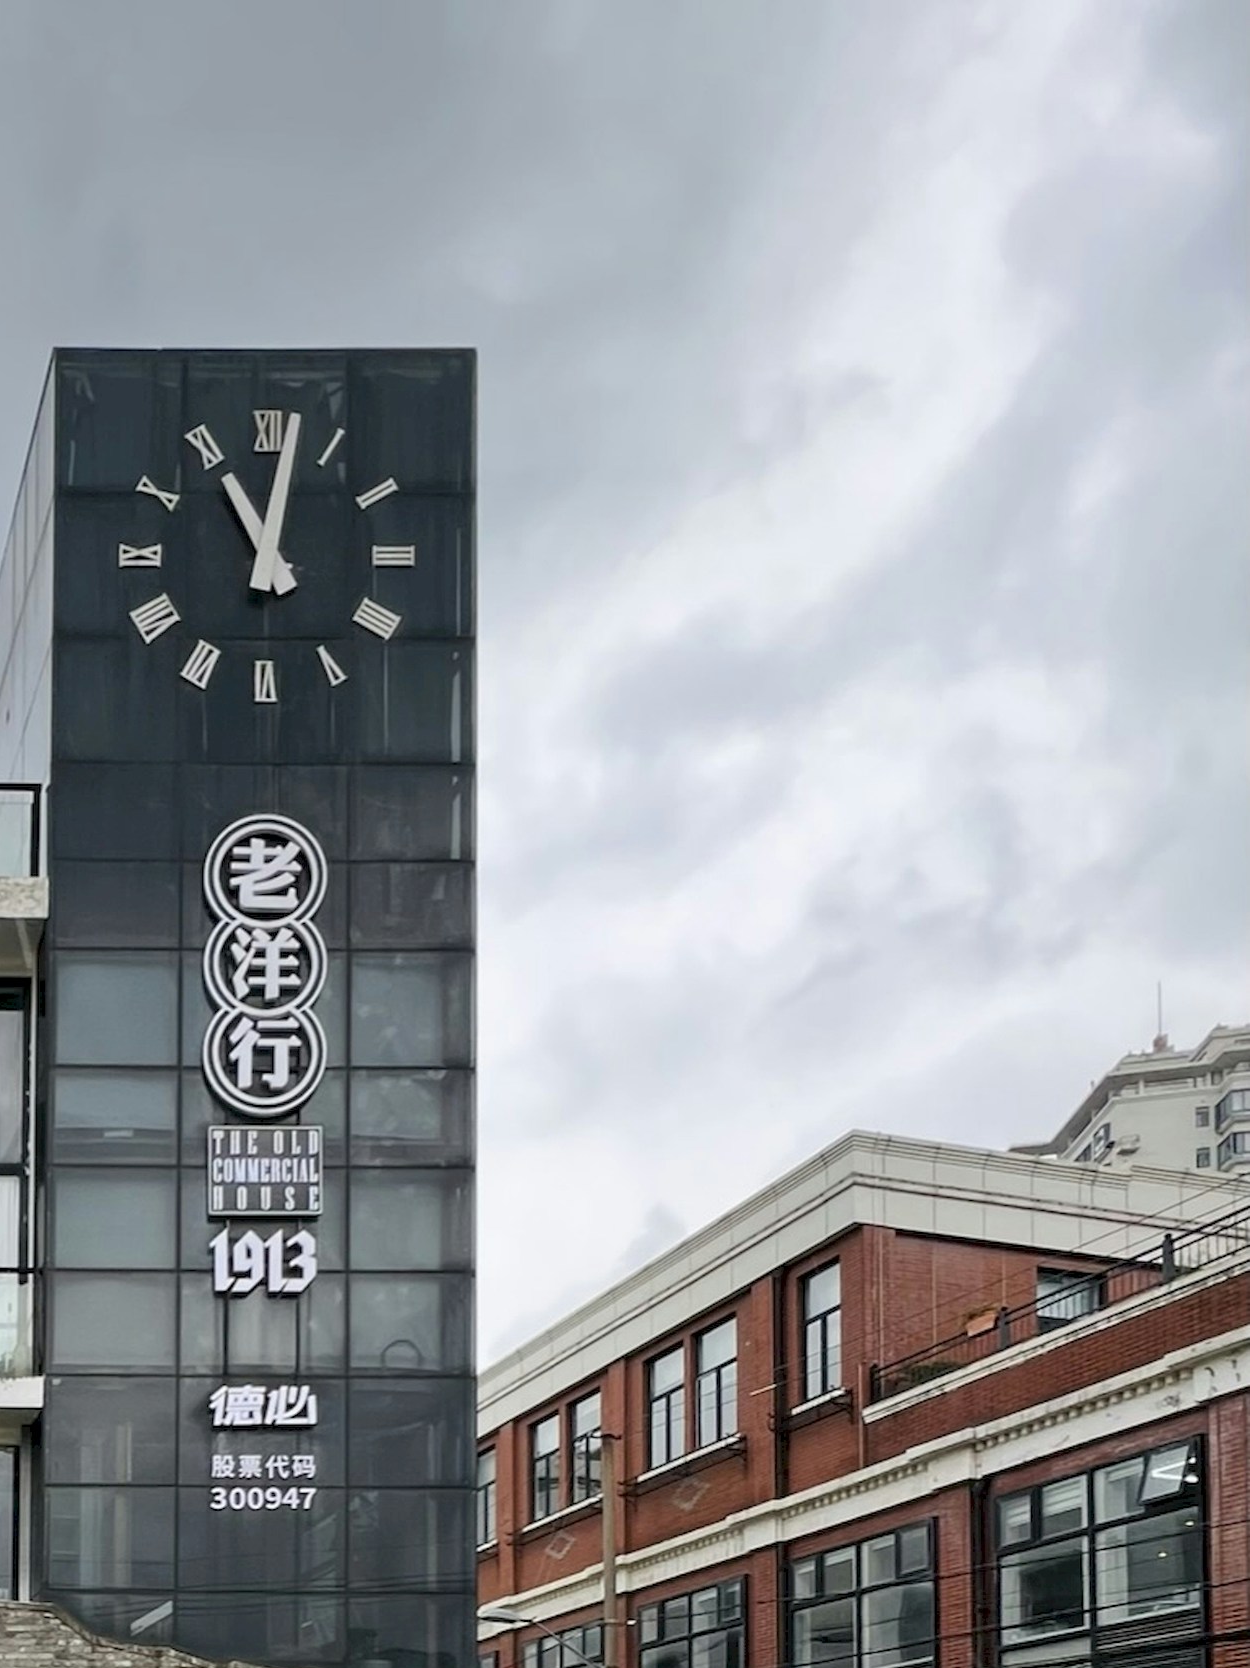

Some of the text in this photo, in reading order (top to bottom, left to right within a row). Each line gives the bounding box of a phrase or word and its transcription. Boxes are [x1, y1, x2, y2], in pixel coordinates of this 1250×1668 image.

[184, 424, 225, 470] XI
[253, 410, 282, 452] XII
[135, 475, 180, 511] X
[355, 478, 399, 510] II
[118, 543, 162, 568] IX
[372, 545, 415, 566] III
[129, 593, 181, 644] VIII
[180, 639, 221, 689] VII
[254, 660, 277, 702] VI
[316, 645, 347, 687] V
[229, 837, 302, 1090] 老洋行
[213, 1130, 319, 1155] THE OLD
[213, 1157, 319, 1183] COMMERCIAL
[213, 1185, 319, 1211] HOUSE
[210, 1228, 318, 1293] 1913
[210, 1385, 318, 1426] 德必
[211, 1455, 316, 1479] 股票代码
[210, 1487, 317, 1511] 300947
